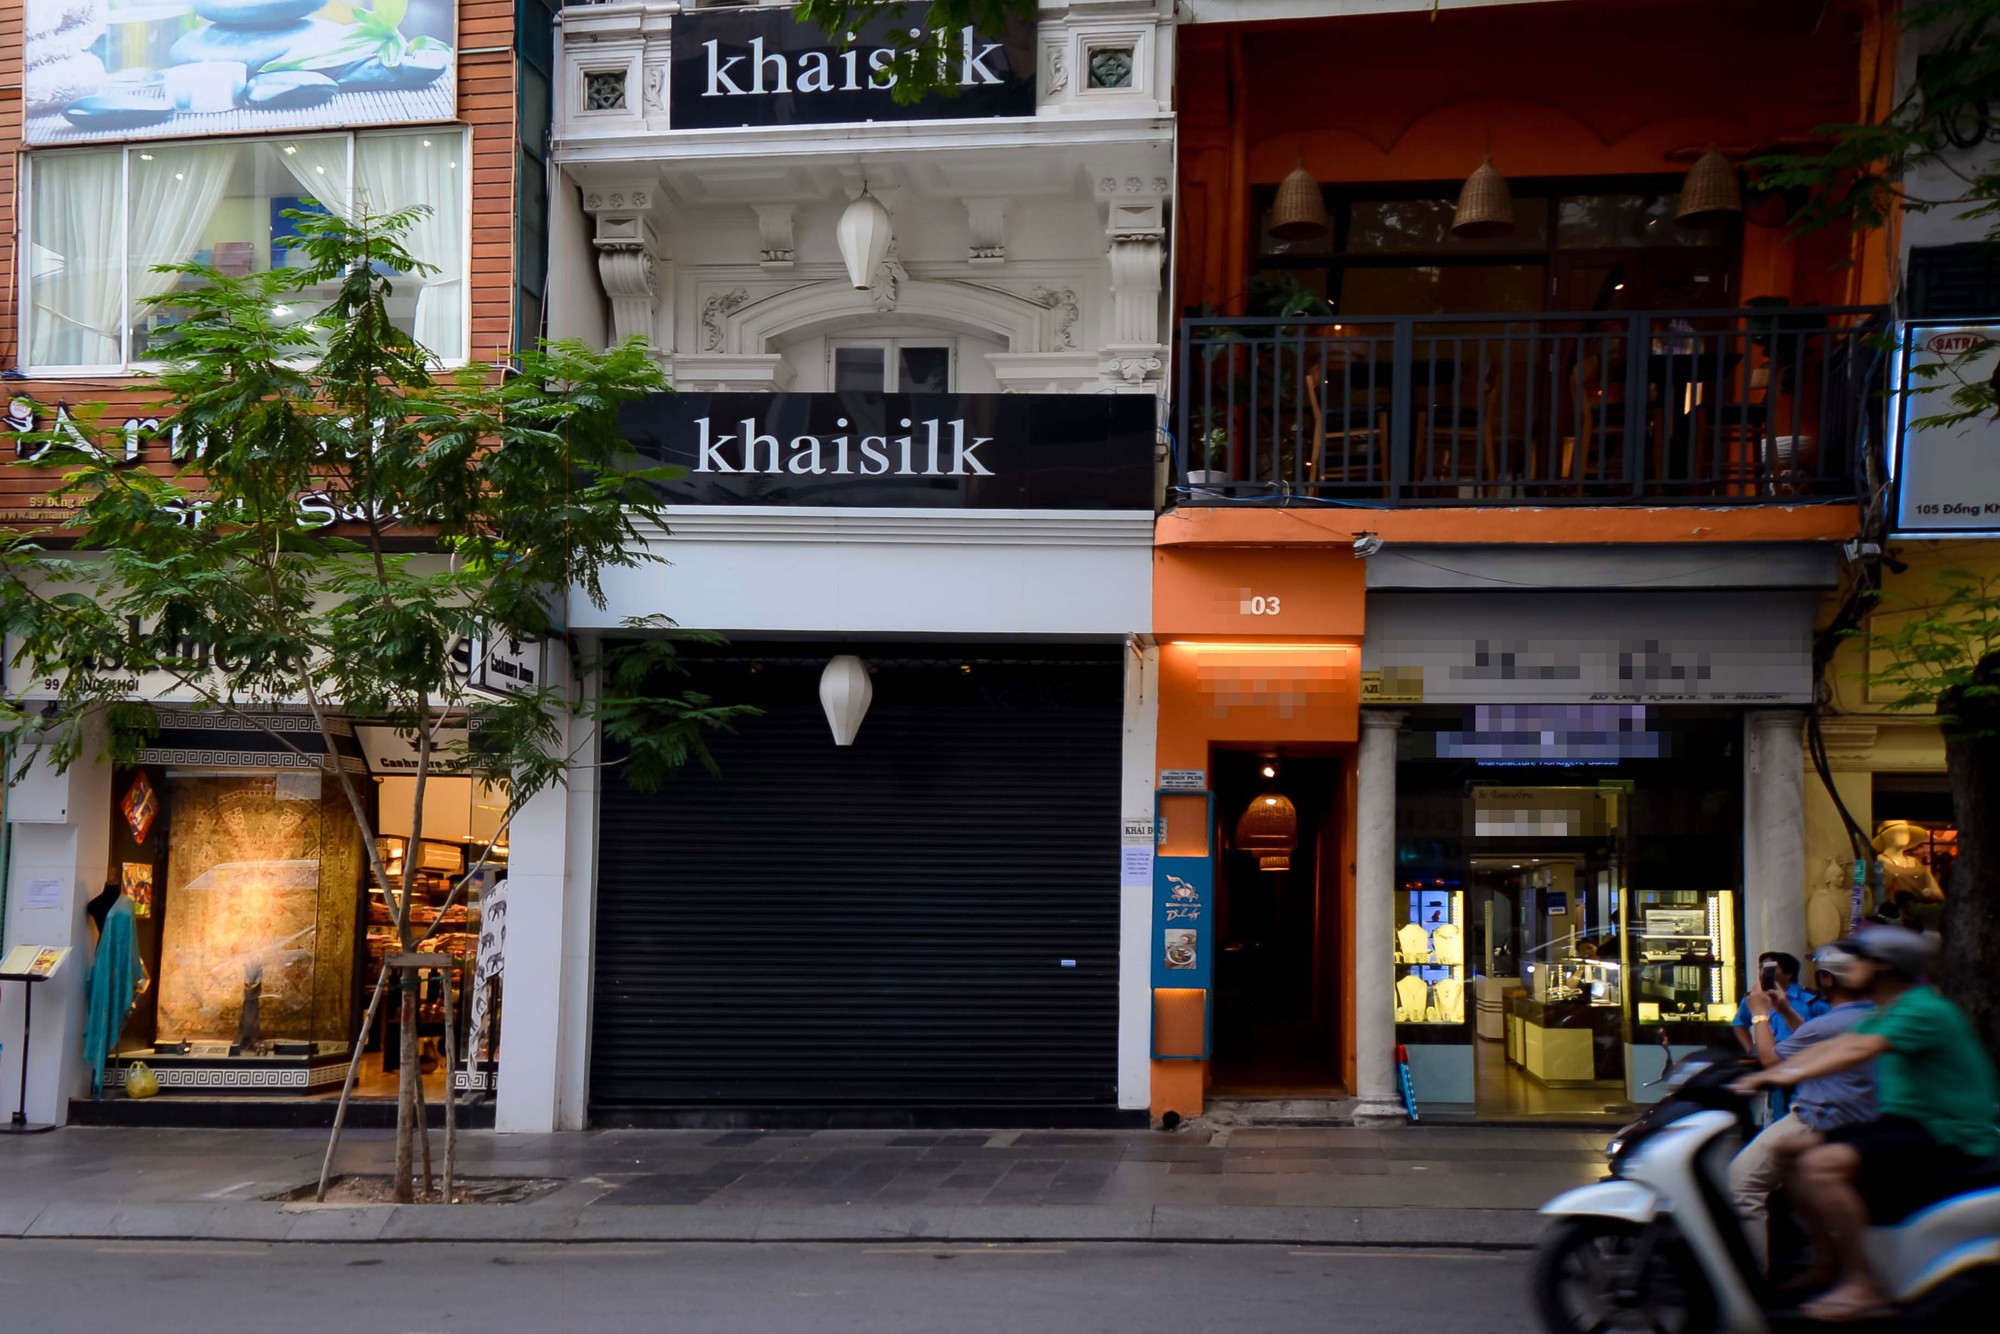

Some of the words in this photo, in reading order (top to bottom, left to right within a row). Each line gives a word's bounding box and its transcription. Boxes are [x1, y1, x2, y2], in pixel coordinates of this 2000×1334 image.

[693, 416, 997, 477] khaisilk
[29, 496, 44, 507] 99
[1916, 504, 1939, 515] 105
[44, 678, 60, 690] 99
[380, 757, 442, 768] Cashre
